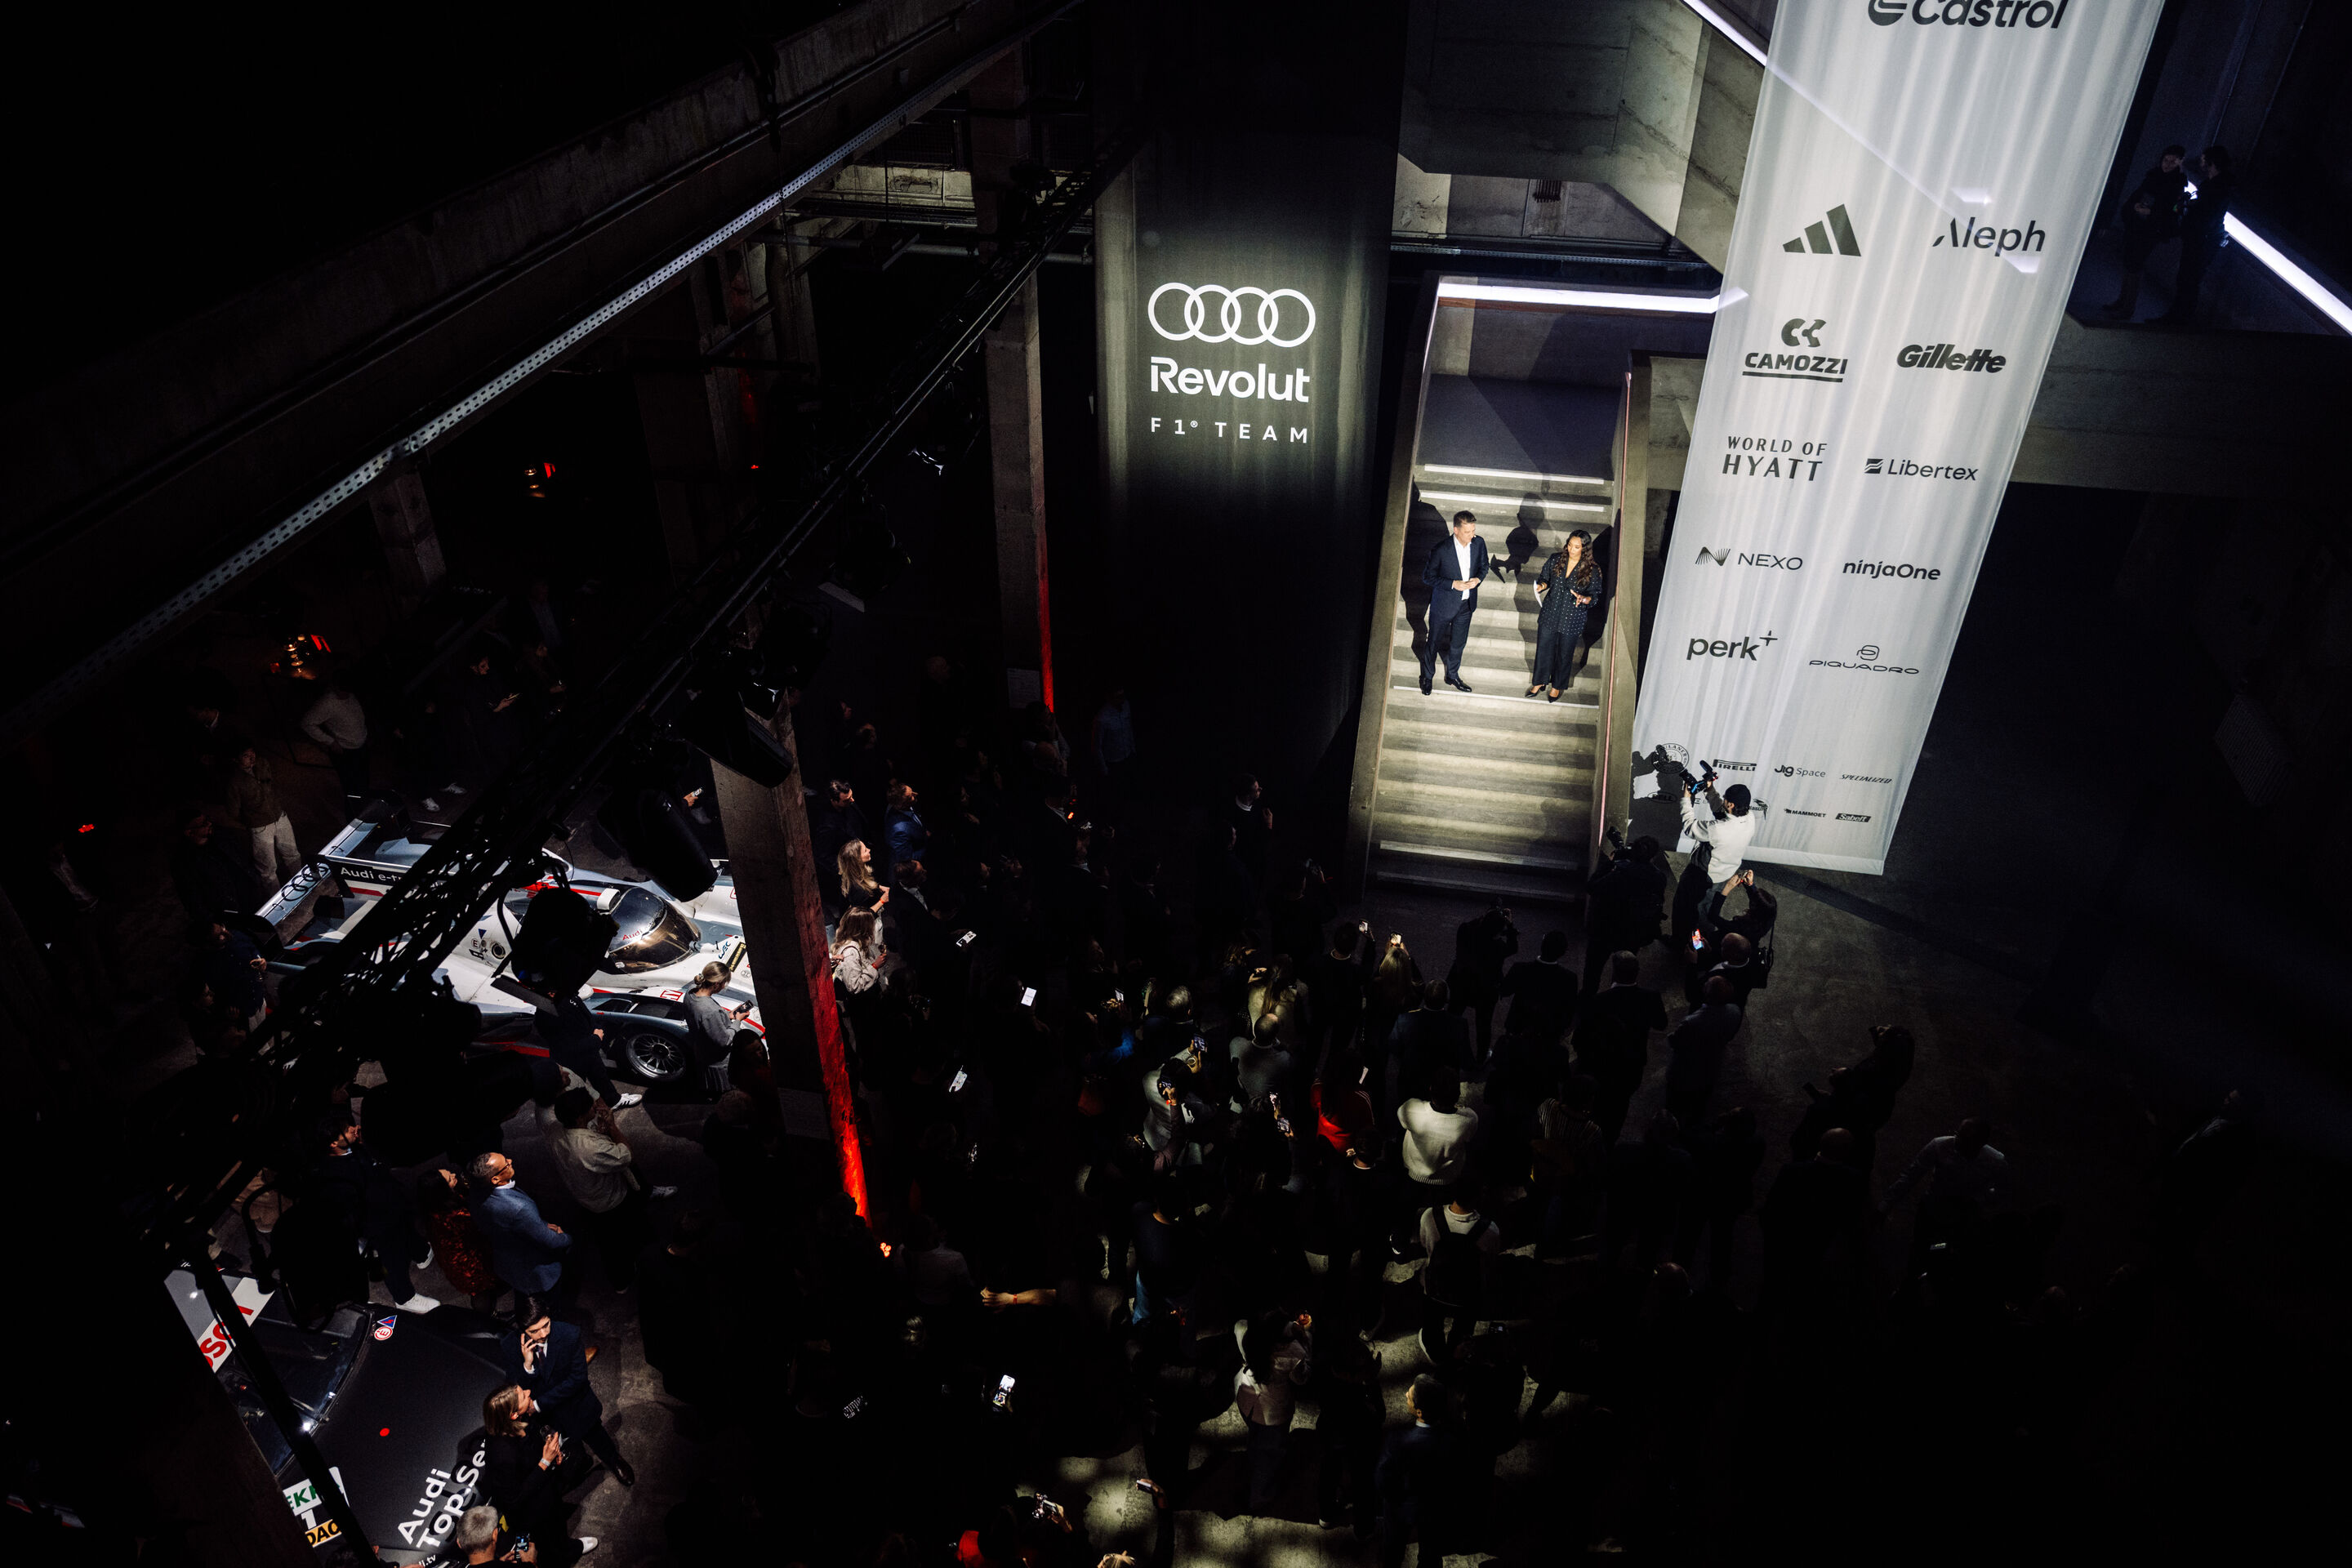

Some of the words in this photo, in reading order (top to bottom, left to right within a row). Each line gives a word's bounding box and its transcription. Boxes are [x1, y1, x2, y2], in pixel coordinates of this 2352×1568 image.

[1911, 0, 2069, 29] Castrol
[1932, 216, 2046, 256] Aleph
[1744, 352, 1847, 374] CAMOZZI
[1896, 343, 2007, 373] Gillette
[1151, 356, 1310, 403] Revolut
[1215, 421, 1307, 443] TEAM
[1727, 435, 1793, 452] WORLD
[1802, 442, 1828, 456] OF
[1722, 453, 1823, 481] HYATT
[1887, 459, 1979, 481] Libertex
[1737, 553, 1803, 570] NEXO
[1842, 559, 1941, 581] ninjaOne
[1809, 659, 1919, 674] PIQUADRO
[1713, 760, 1757, 772] PIRELLI
[1841, 774, 1893, 784] SPECIALIZED
[1792, 809, 1827, 817] MAMMOET
[341, 866, 375, 880] Audi
[622, 929, 643, 941] Audi
[398, 1468, 451, 1545] Audi
